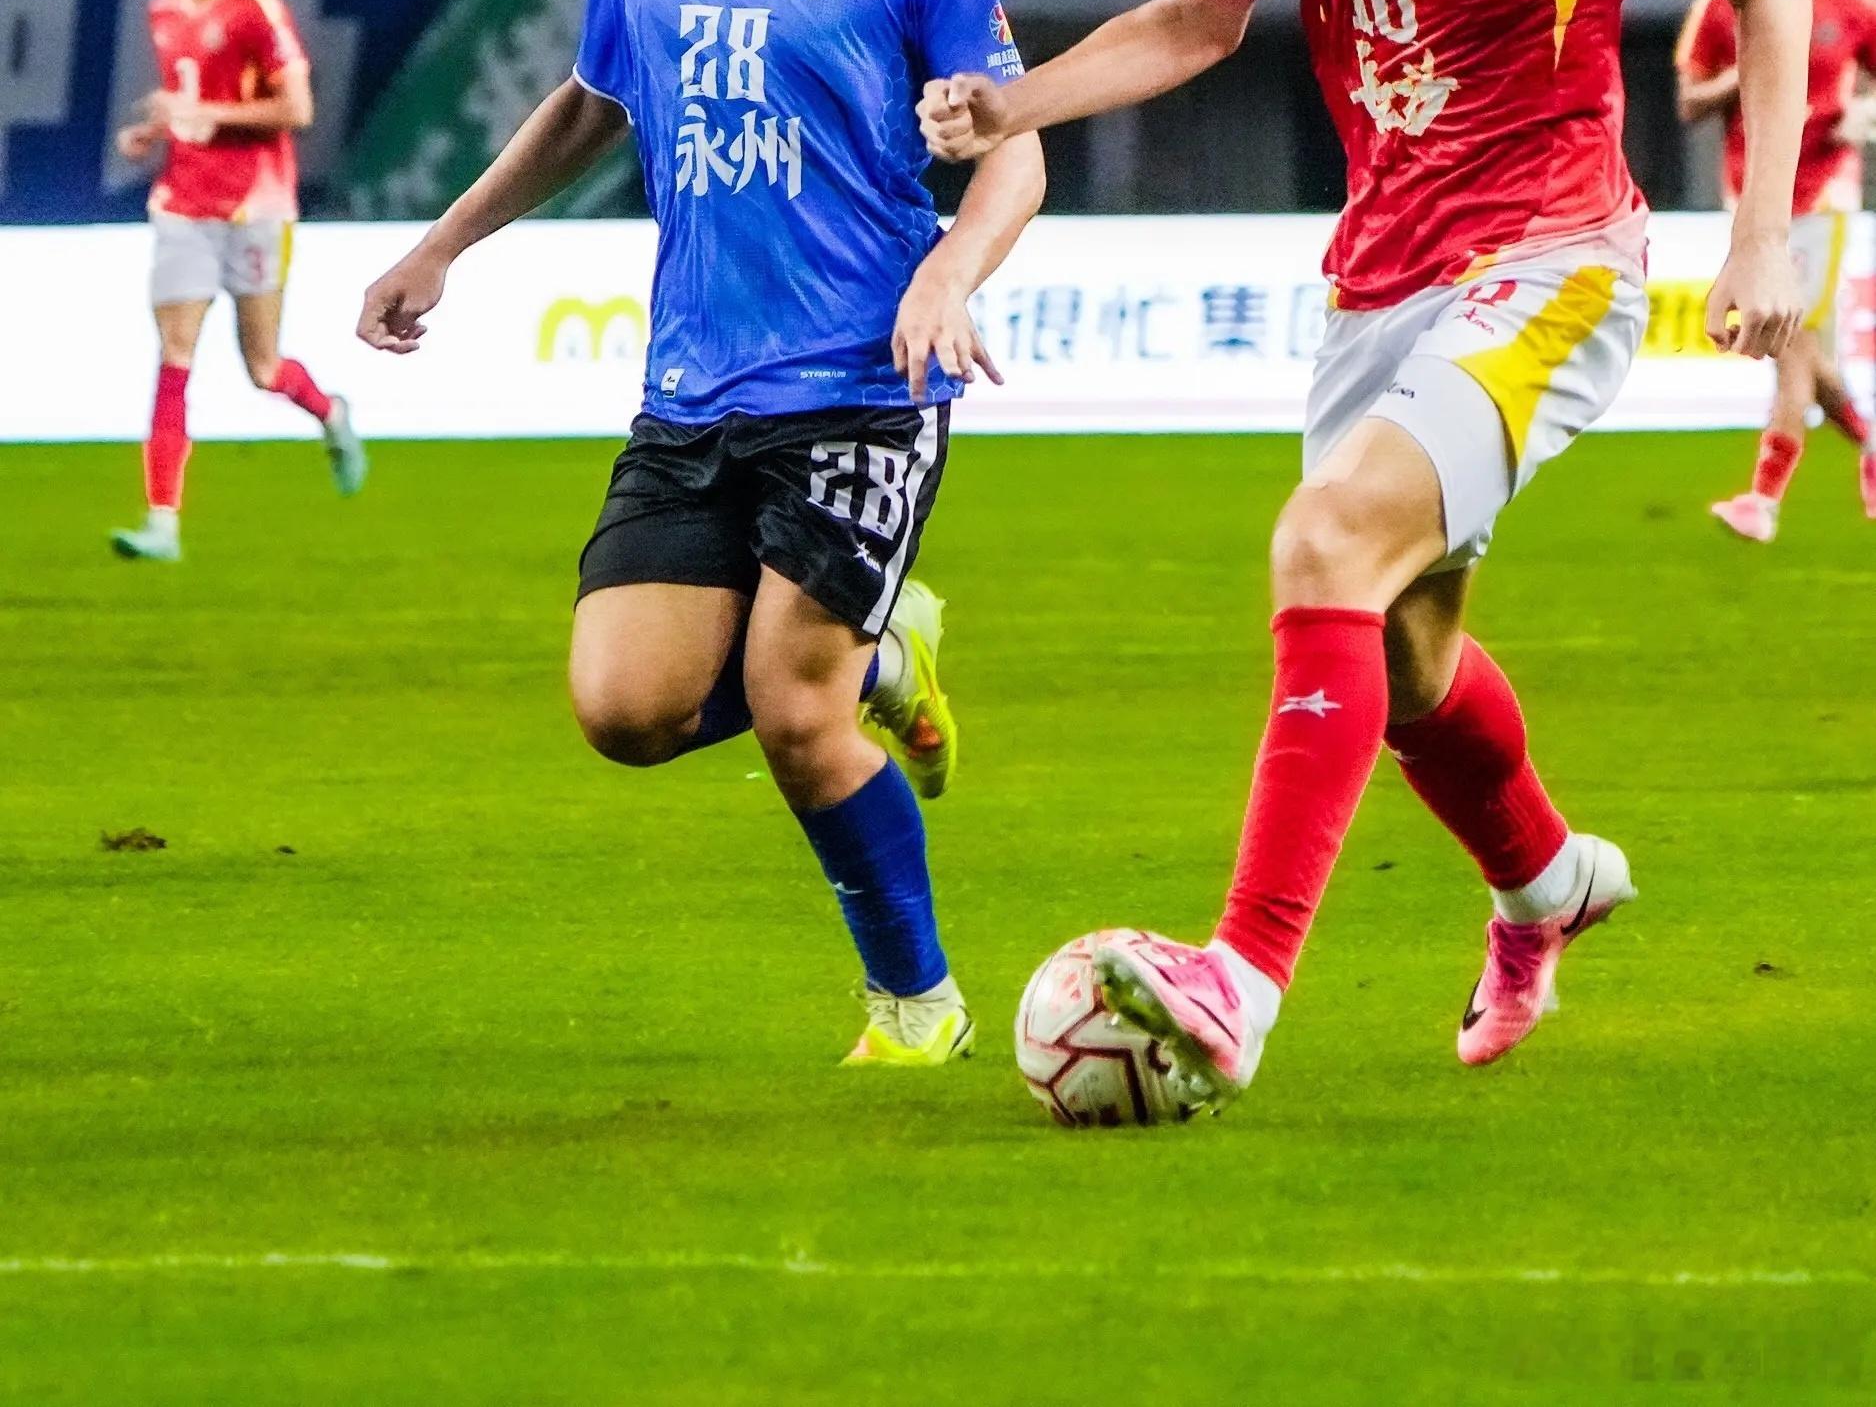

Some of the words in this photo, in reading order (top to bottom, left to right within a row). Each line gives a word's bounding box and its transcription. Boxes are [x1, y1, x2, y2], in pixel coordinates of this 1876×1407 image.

[679, 4, 772, 104] 28
[675, 103, 802, 202] 永州
[806, 441, 910, 542] 28
